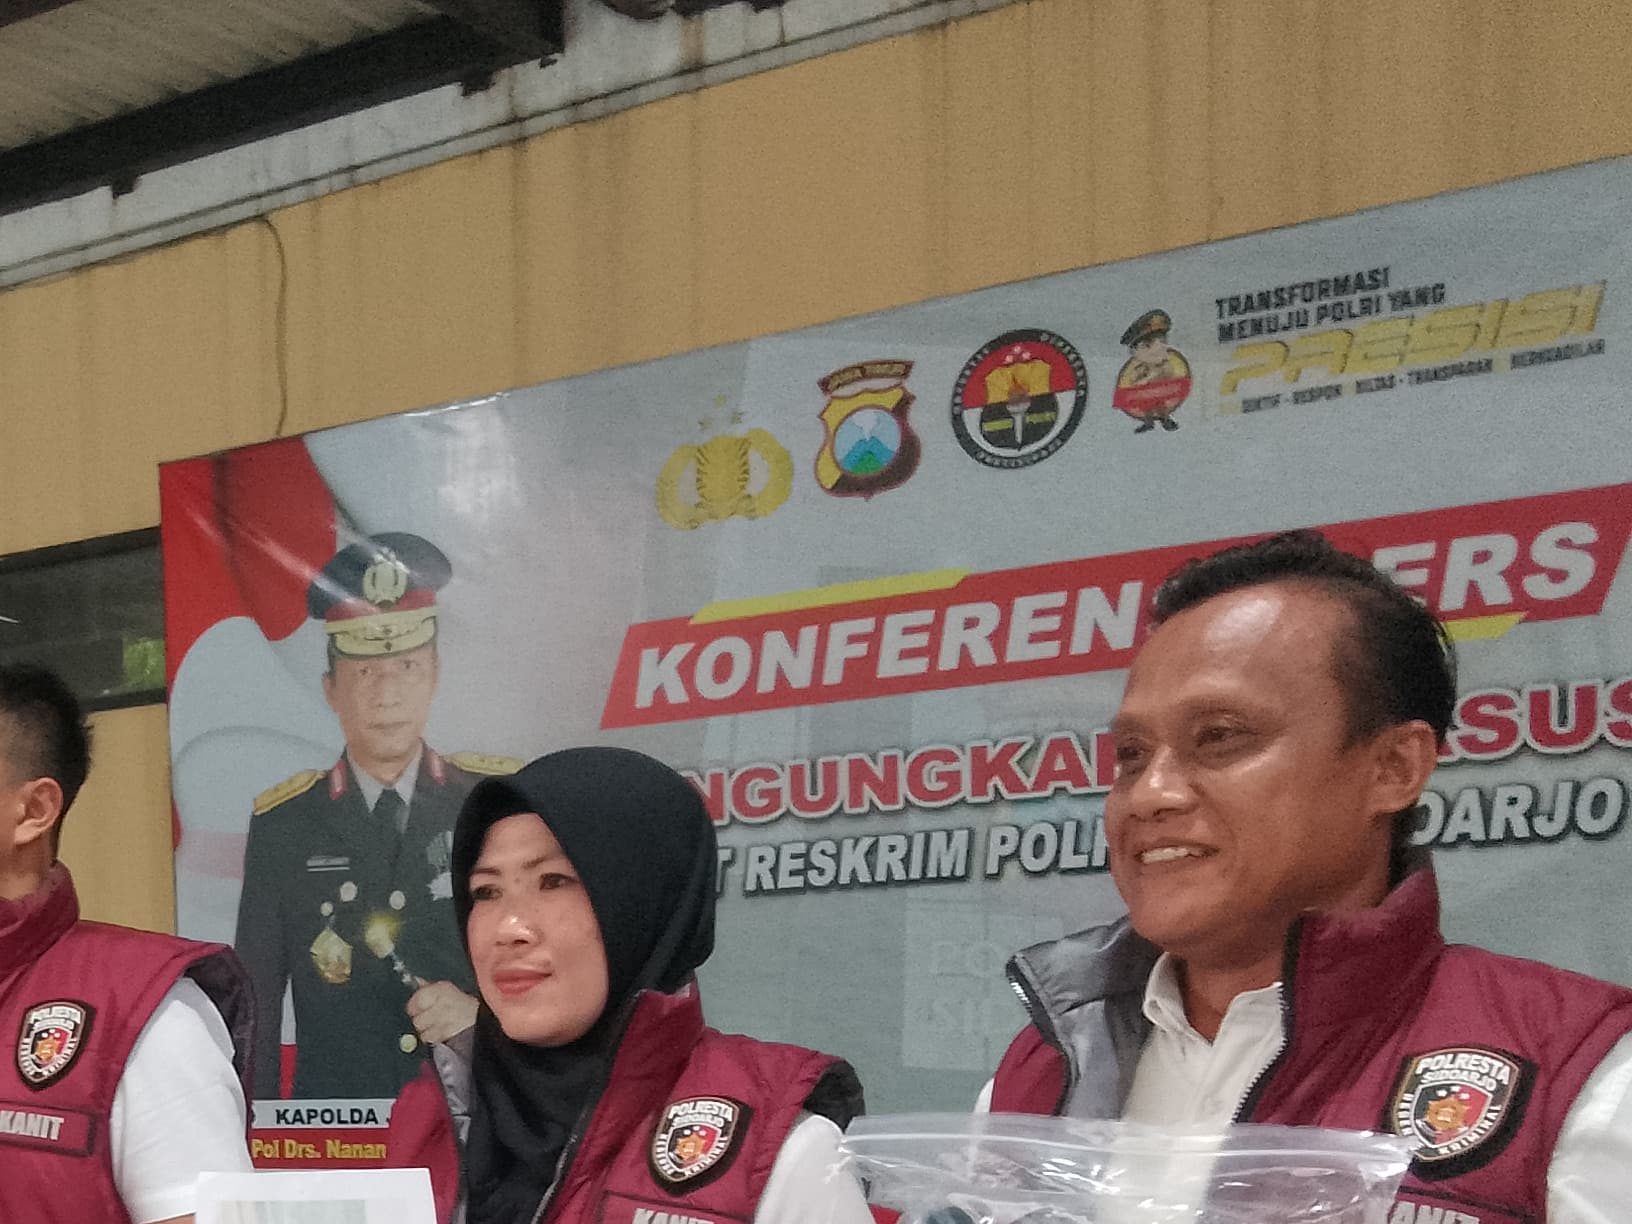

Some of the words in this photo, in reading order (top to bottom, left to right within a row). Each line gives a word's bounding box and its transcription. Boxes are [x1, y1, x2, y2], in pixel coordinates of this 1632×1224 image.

[1215, 266, 1390, 320] TRANSFORMASI
[1218, 306, 1309, 343] MENUJU
[1316, 294, 1382, 325] POLRI
[1388, 282, 1446, 313] YANG
[635, 582, 1143, 709] KONFEREN
[1372, 521, 1599, 613] ERS
[744, 828, 971, 892] RESKRIM
[1415, 1053, 1510, 1085] POLRESTA
[275, 1107, 379, 1125] KAPOLDA
[668, 1101, 733, 1121] POLRESTA
[252, 1138, 279, 1159] Pol
[285, 1139, 321, 1159] Drs.
[326, 1139, 386, 1160] Nanan
